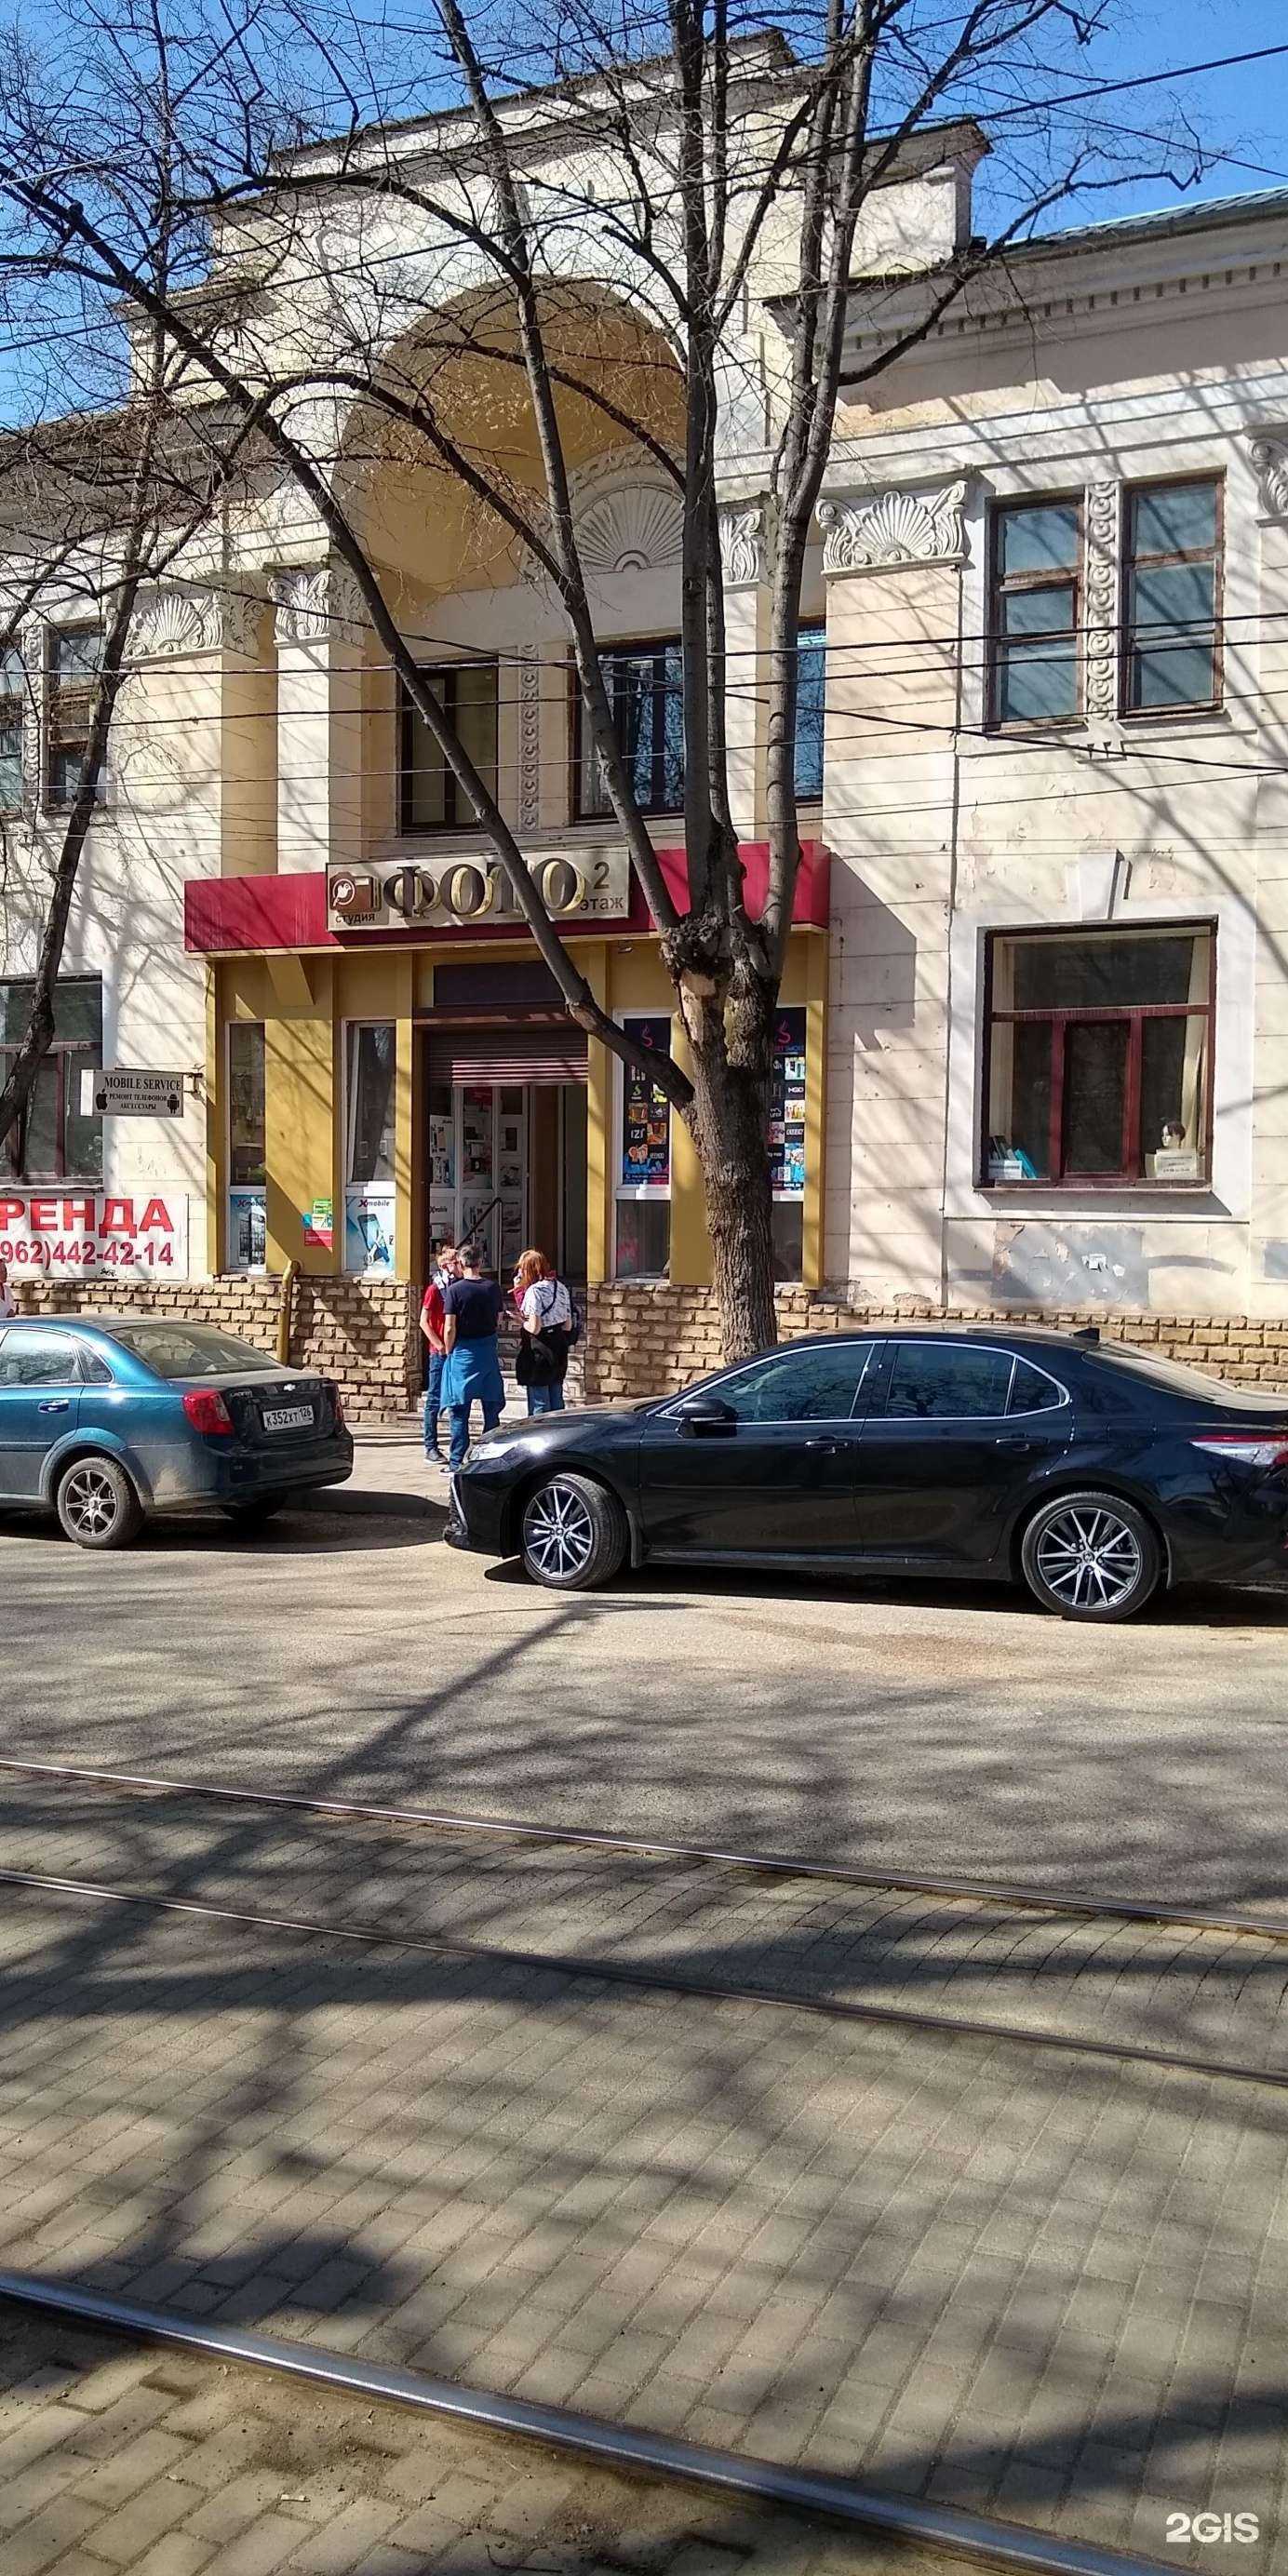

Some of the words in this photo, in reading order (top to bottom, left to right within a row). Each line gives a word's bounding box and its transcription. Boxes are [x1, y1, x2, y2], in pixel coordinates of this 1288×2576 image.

[593, 862, 610, 890] 2
[383, 858, 584, 918] ФОТО
[579, 896, 624, 911] этаж
[335, 913, 375, 924] студия
[104, 1077, 141, 1090] MOBILE
[143, 1079, 181, 1091] SERVICE
[109, 1093, 132, 1101] РЕМОНТ
[0, 1198, 175, 1239] РЕНДА
